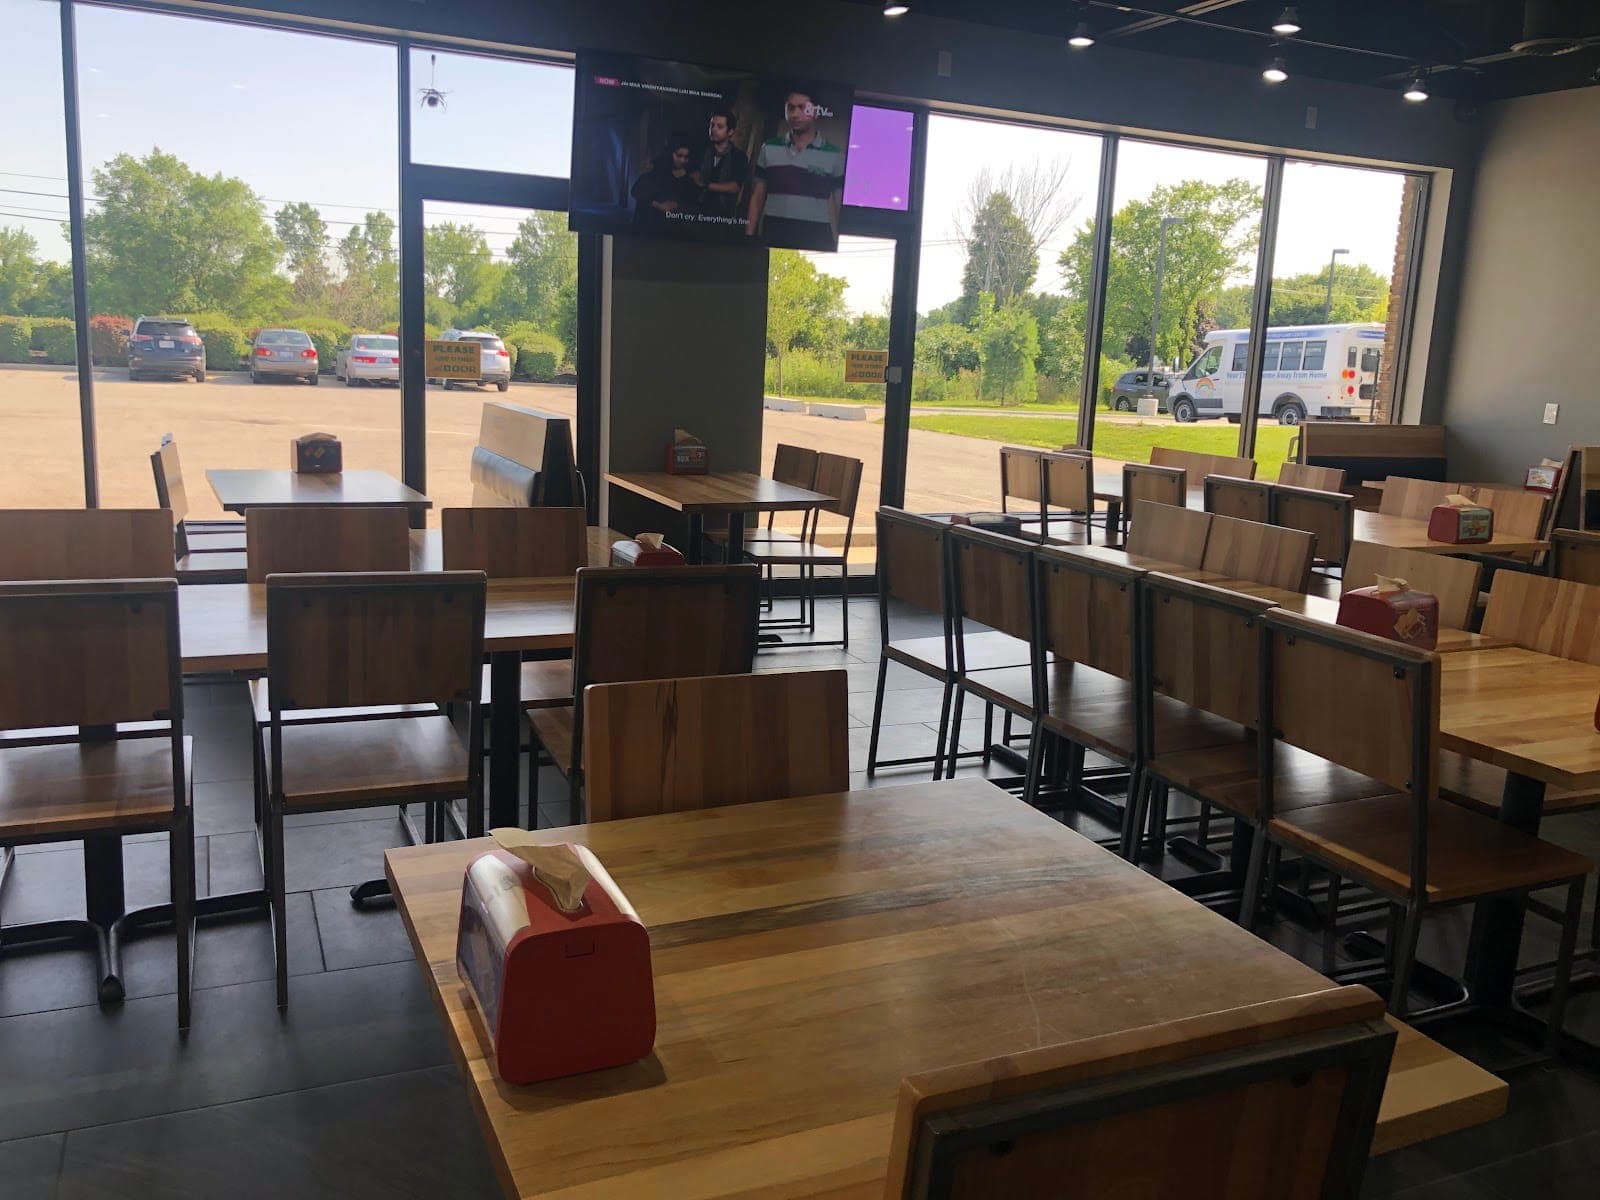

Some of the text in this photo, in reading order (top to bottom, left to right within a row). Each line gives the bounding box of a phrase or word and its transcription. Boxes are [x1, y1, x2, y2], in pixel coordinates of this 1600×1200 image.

[599, 78, 615, 86] NOW
[665, 211, 683, 219] Don't
[698, 214, 737, 225] Everything's
[432, 345, 474, 353] PLEASE
[850, 353, 883, 361] PLEASE
